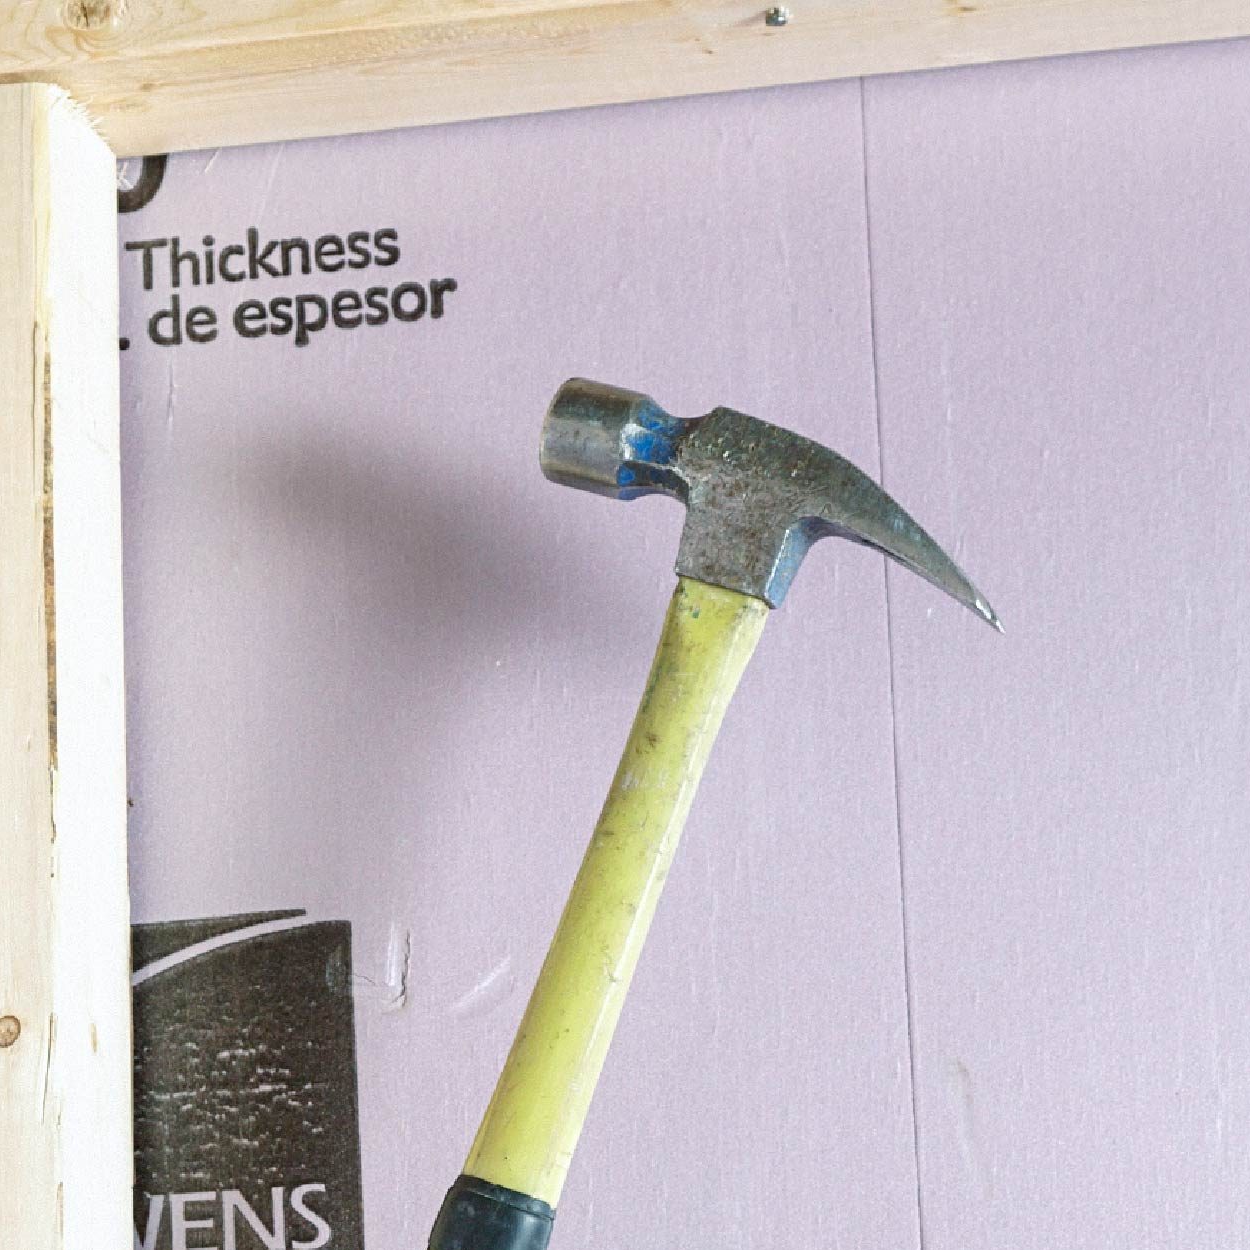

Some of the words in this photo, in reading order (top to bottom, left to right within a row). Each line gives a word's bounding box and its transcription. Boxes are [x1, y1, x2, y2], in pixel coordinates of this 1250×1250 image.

[124, 226, 400, 292] Thickness
[148, 294, 218, 347] de
[232, 278, 458, 347] espesor
